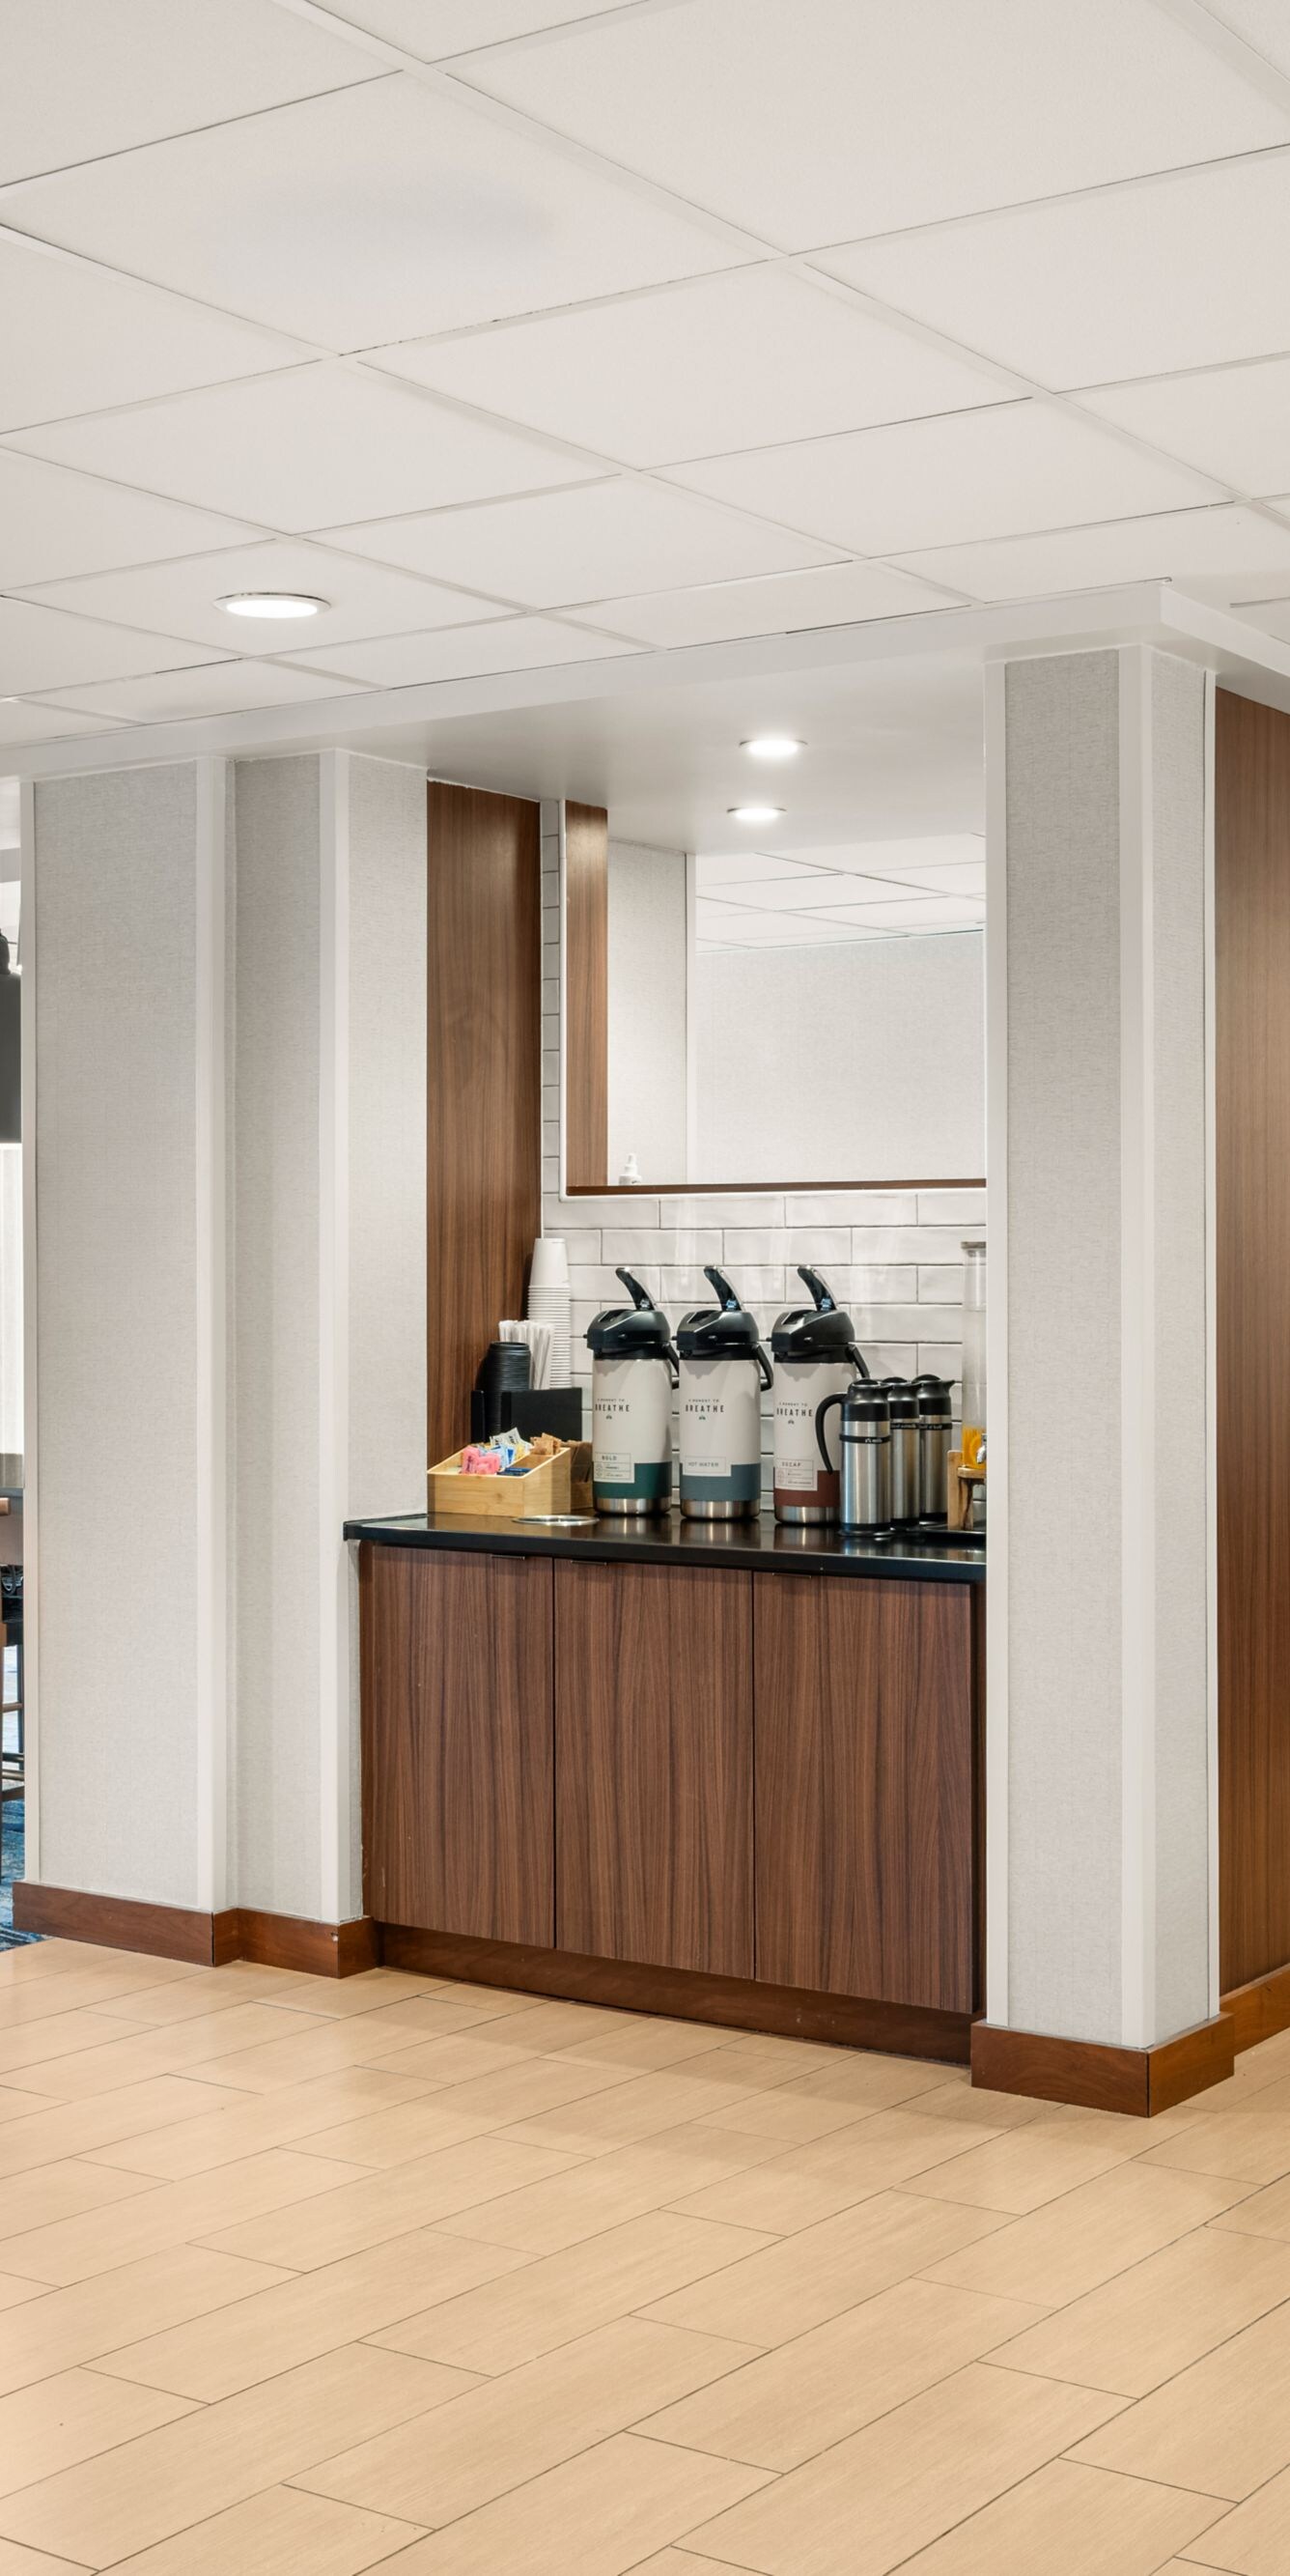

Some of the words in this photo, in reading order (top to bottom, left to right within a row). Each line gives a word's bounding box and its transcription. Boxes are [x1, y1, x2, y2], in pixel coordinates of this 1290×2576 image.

[595, 1403, 630, 1412] BREATHE
[685, 1404, 724, 1413] BREATHE
[776, 1406, 813, 1417] BREATHE
